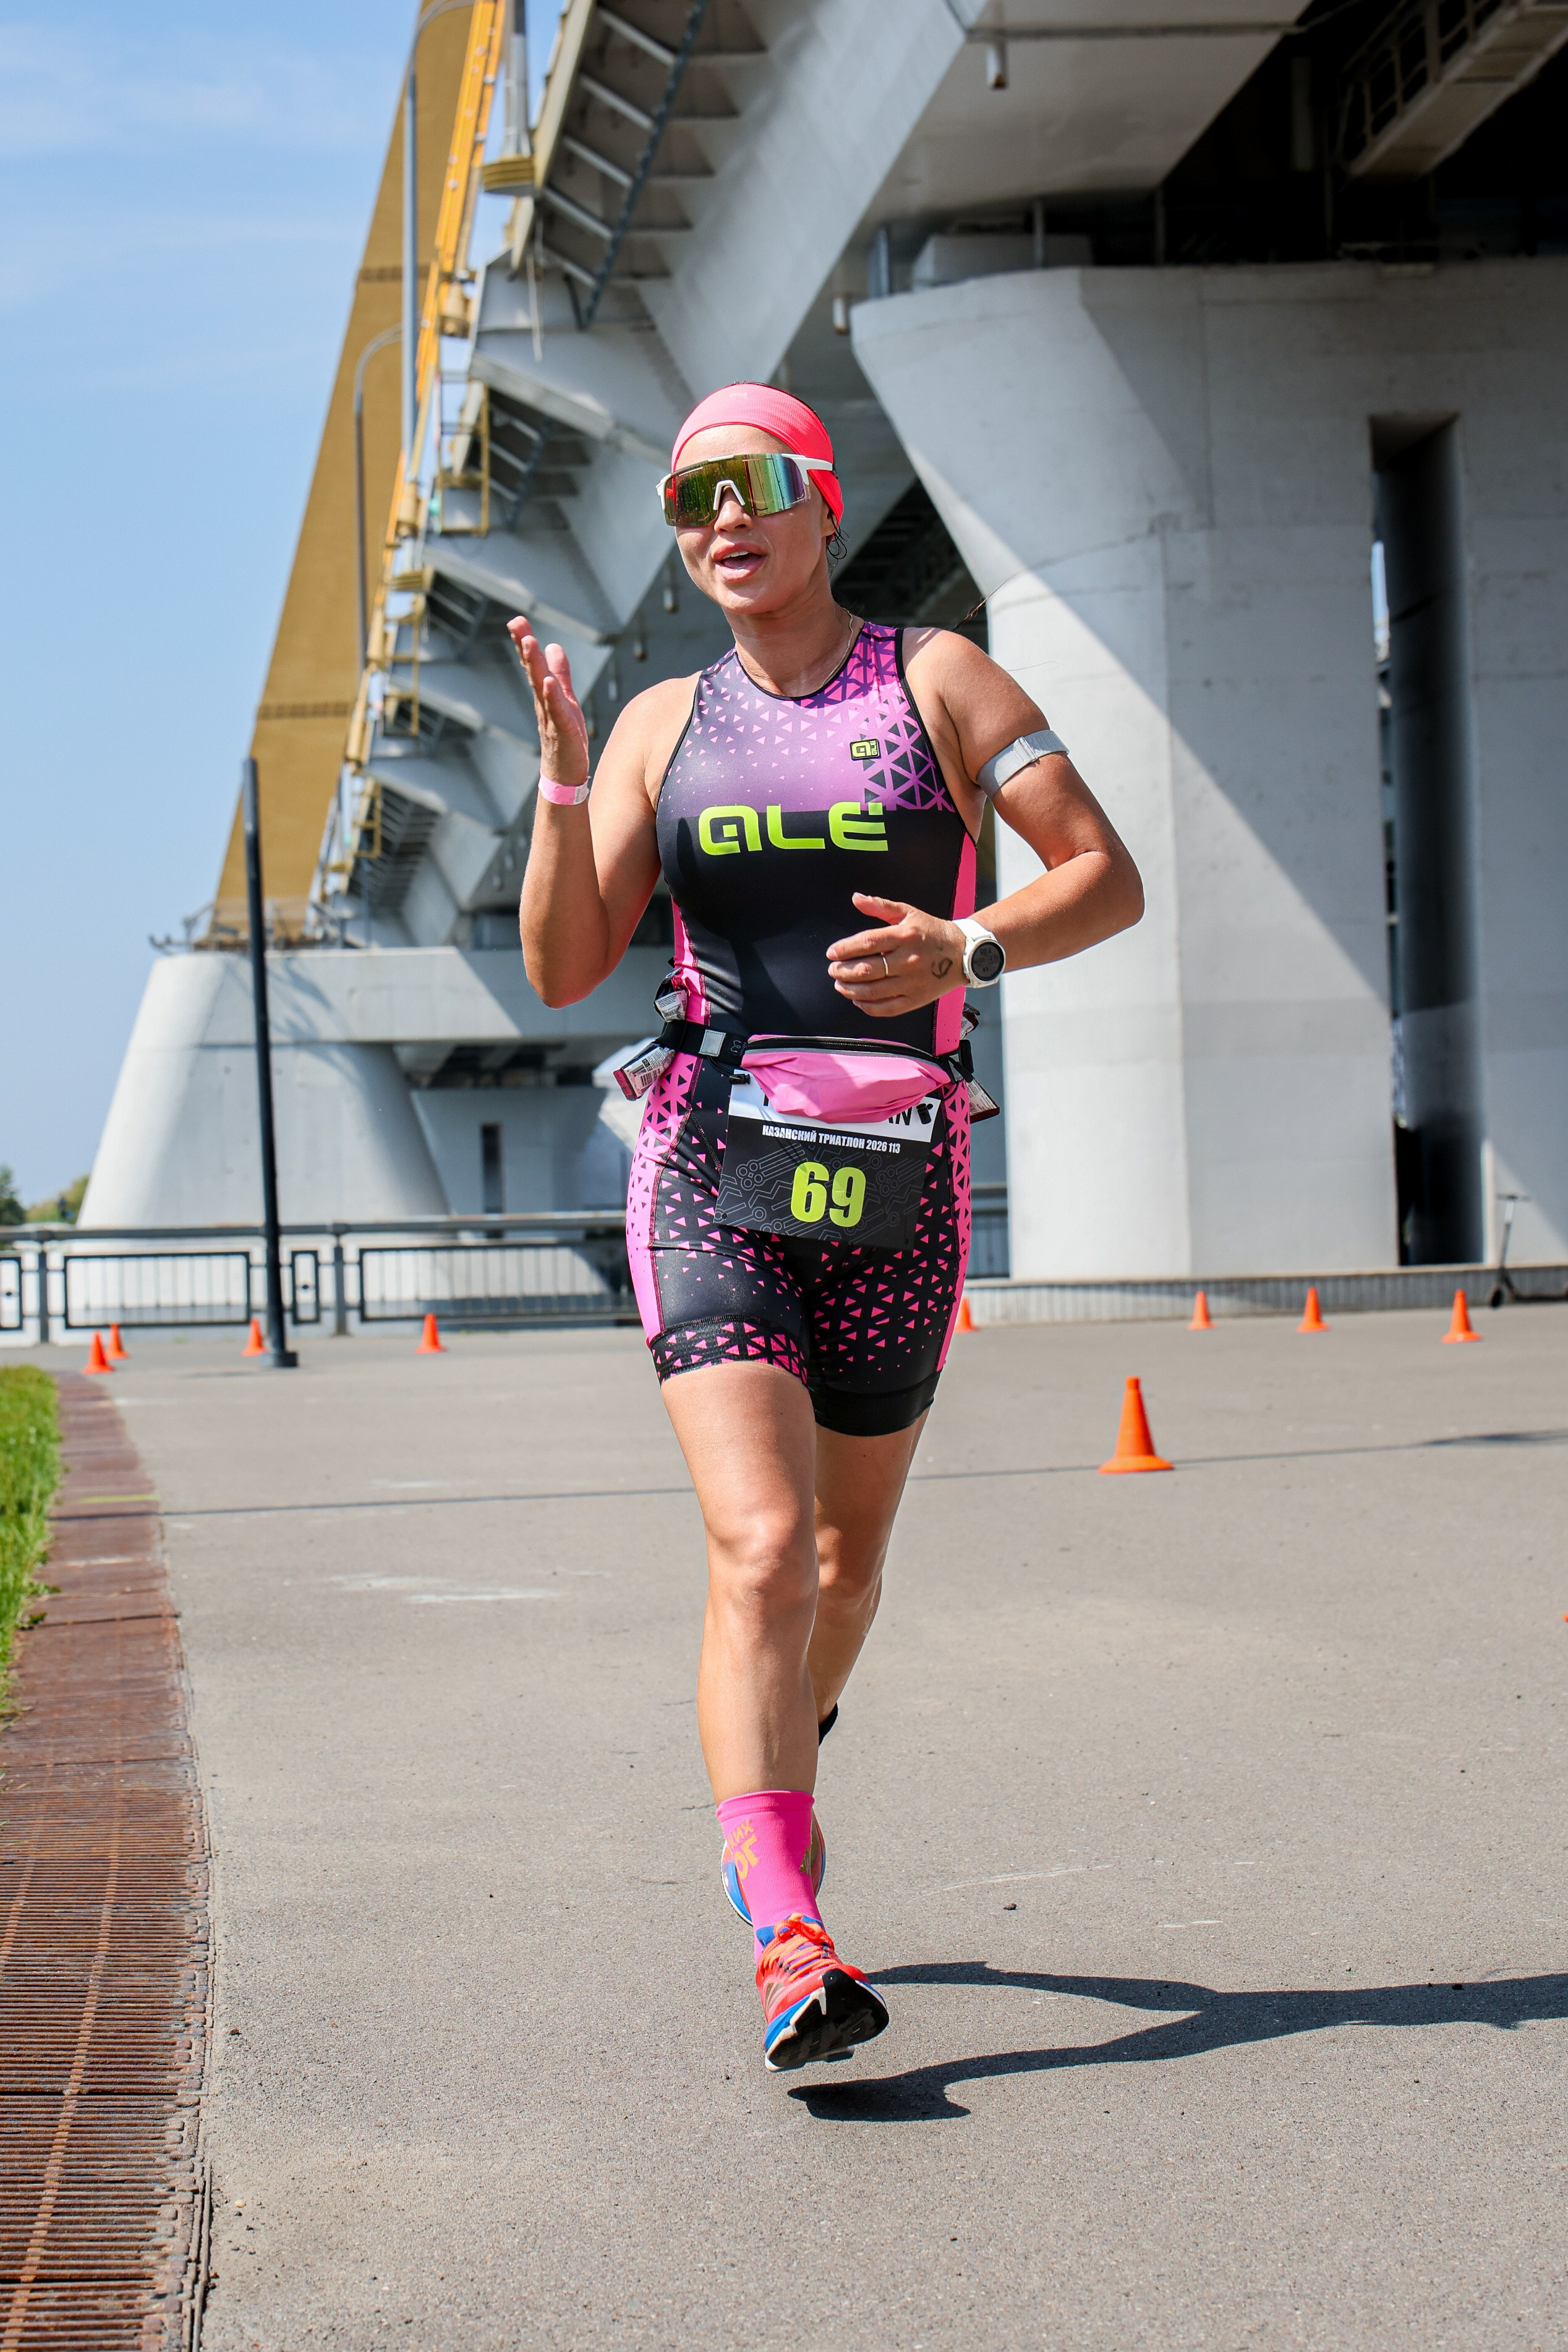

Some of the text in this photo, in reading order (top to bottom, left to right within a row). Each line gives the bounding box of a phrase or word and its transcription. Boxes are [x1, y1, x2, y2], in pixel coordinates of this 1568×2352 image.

[762, 1125, 900, 1154] КАЗАНСКИЙ ТРИАТЛОН 2026 113
[790, 1162, 866, 1227] 69
